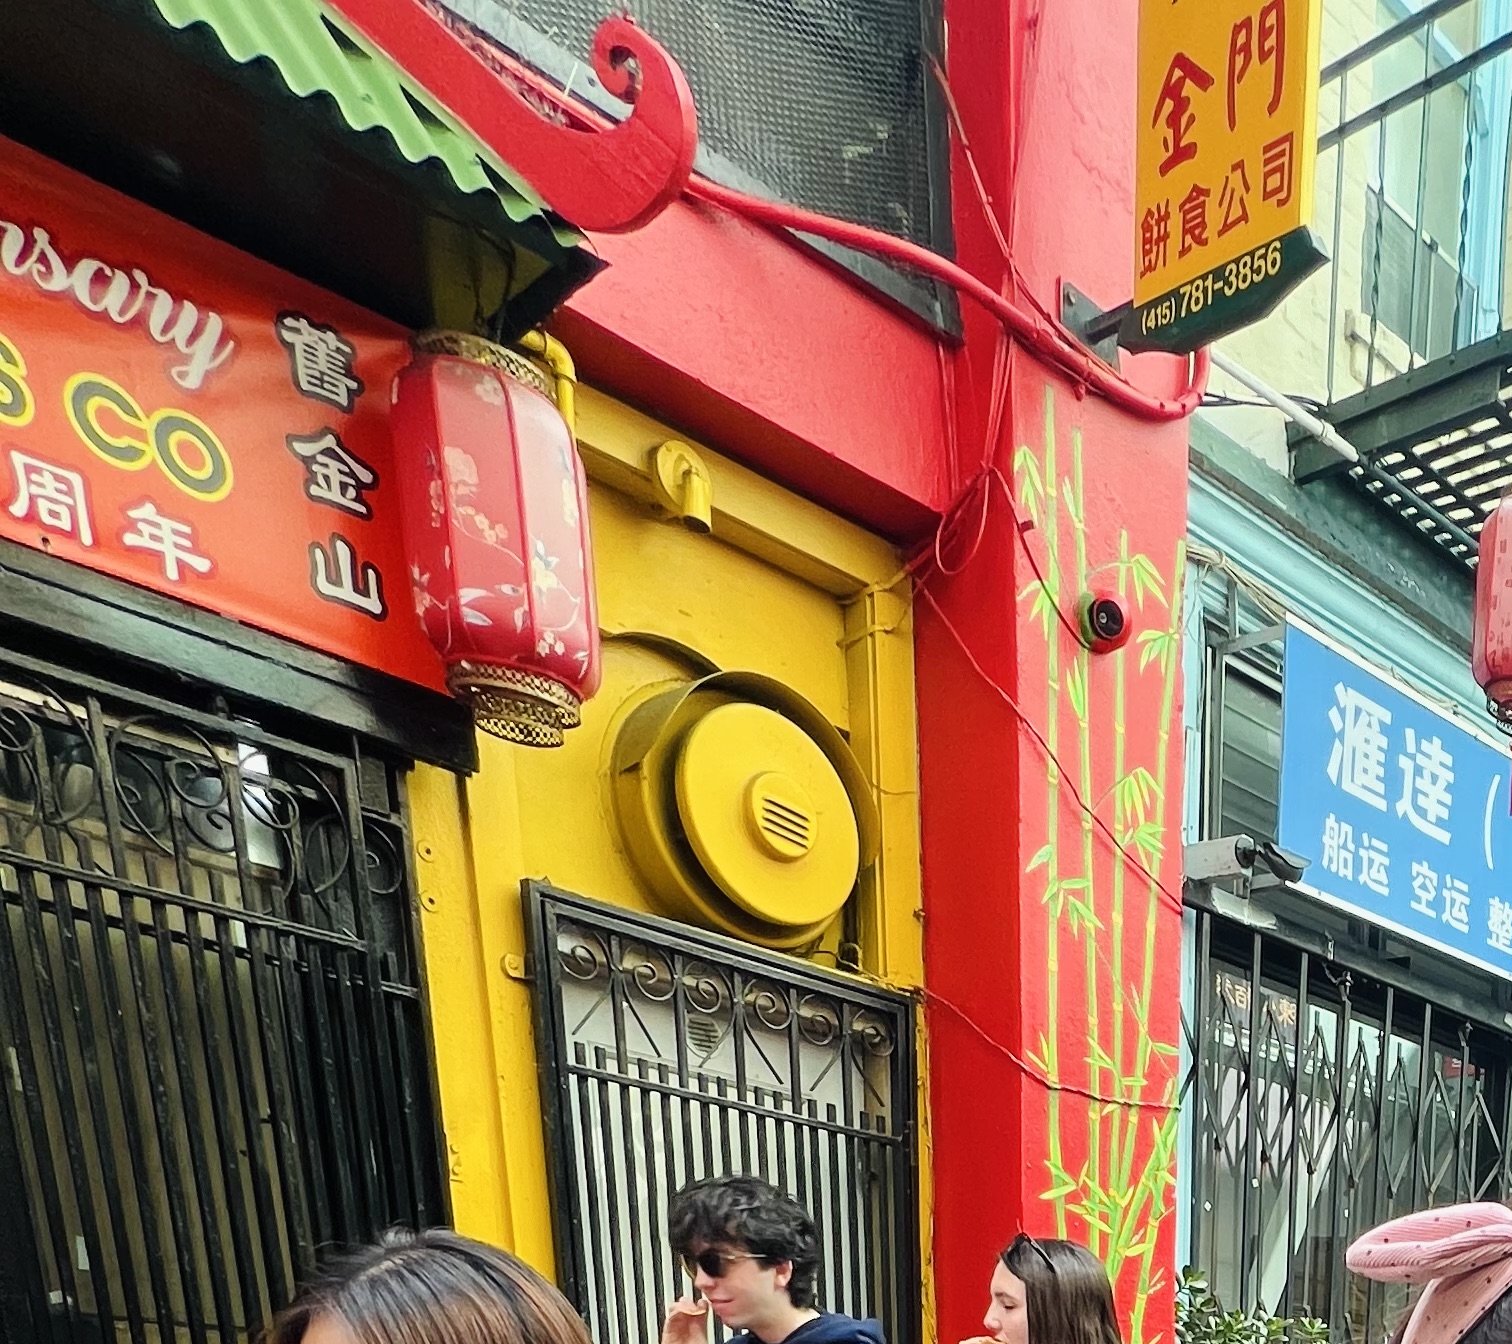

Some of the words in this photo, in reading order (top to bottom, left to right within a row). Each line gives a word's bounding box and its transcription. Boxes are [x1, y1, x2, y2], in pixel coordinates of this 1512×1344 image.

[1151, 0, 1286, 178] 金門
[1139, 131, 1294, 279] 餅食公司
[1141, 297, 1176, 335] (415)
[1180, 240, 1282, 317] 781-3856
[64, 371, 234, 502] CO
[277, 312, 388, 621] 舊金山
[9, 450, 213, 581] 周年
[1321, 812, 1390, 897] 船运
[1410, 857, 1471, 934] 空运
